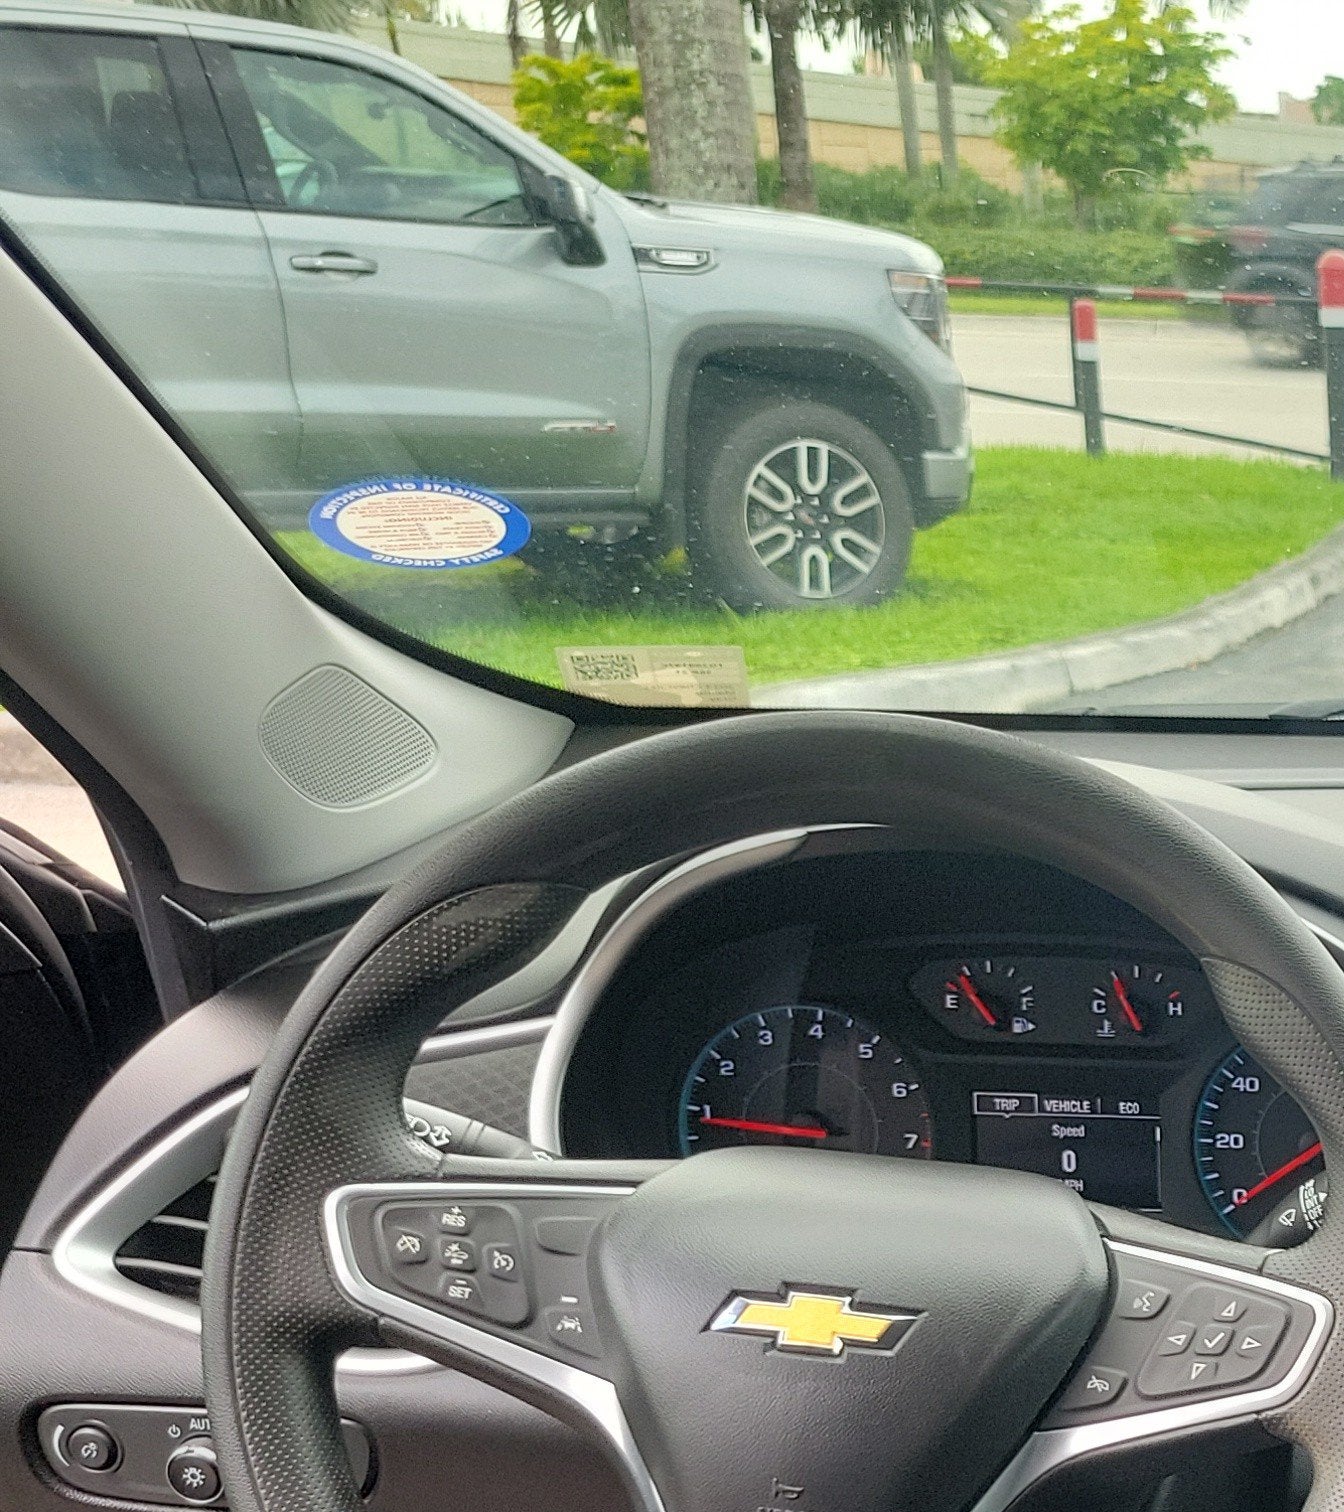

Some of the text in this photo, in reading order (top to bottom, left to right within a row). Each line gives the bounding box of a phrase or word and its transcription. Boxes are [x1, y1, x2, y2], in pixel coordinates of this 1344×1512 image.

[945, 994, 959, 1009] E
[1021, 997, 1034, 1011] F
[1092, 1000, 1107, 1014] C
[1168, 1002, 1183, 1016] H
[758, 1030, 774, 1046] 3
[808, 1024, 825, 1040] 4
[858, 1044, 874, 1060] 5
[719, 1060, 735, 1076] 2
[892, 1082, 908, 1098] 6
[1231, 1077, 1260, 1092] 40
[703, 1104, 712, 1119] 1
[994, 1098, 1020, 1112] TRIP
[1044, 1099, 1092, 1114] VEHICLE
[1118, 1102, 1140, 1114] ECO
[1052, 1124, 1085, 1139] Speed
[903, 1134, 919, 1149] 7
[1215, 1133, 1244, 1149] 20
[1061, 1150, 1077, 1173] 0
[442, 1212, 467, 1227] RES
[448, 1285, 473, 1299] SET
